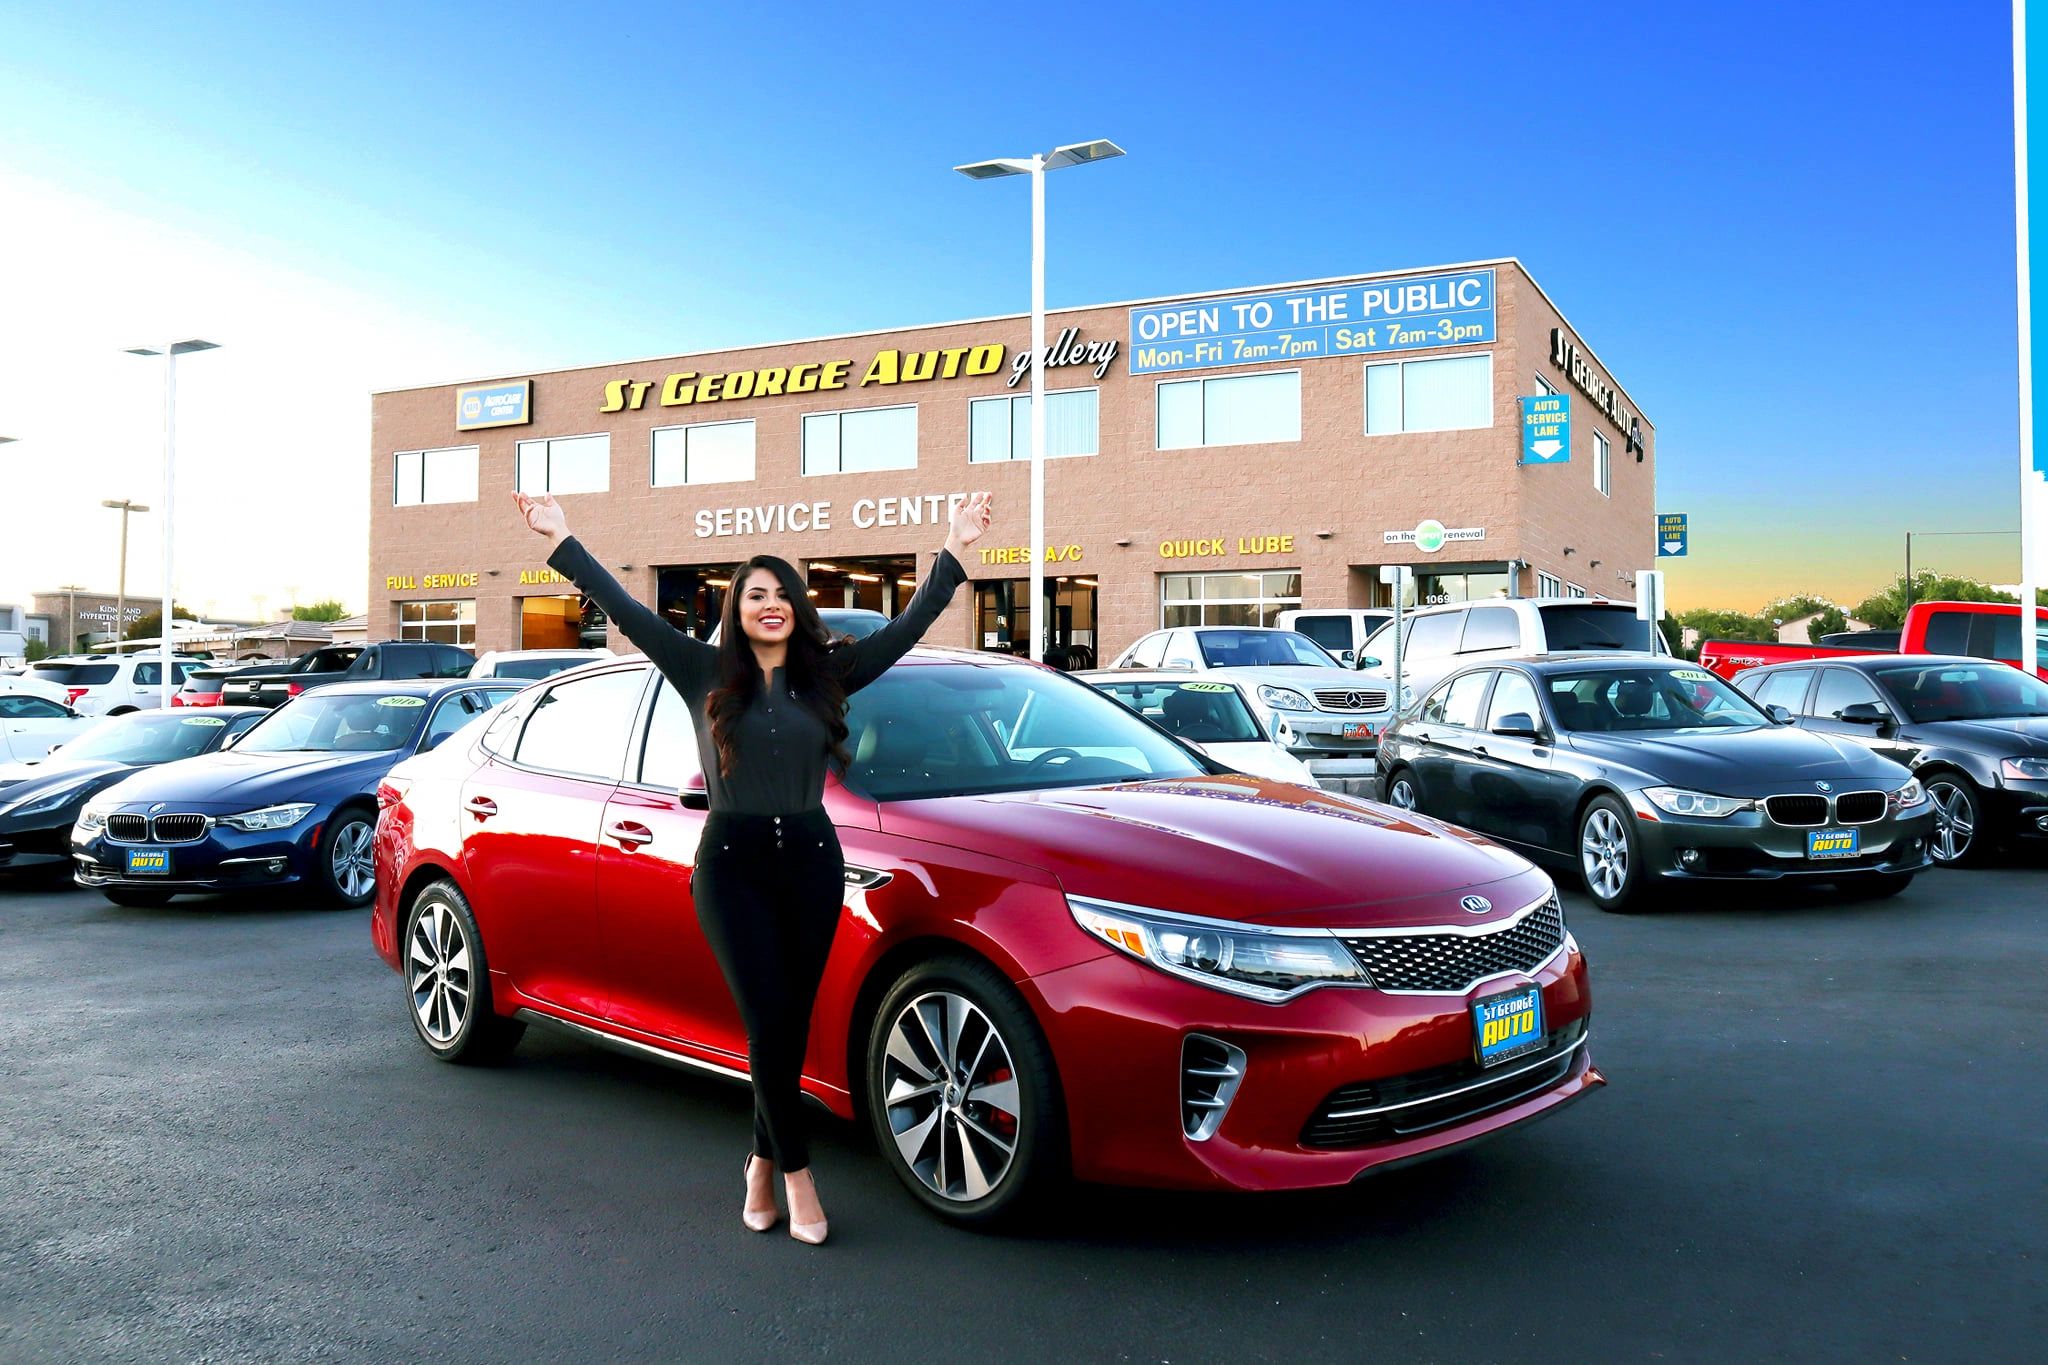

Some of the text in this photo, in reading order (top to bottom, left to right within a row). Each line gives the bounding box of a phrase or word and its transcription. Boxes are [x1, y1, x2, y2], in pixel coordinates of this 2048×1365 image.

[1138, 278, 1482, 340] OPEN TO THE PUBLIC
[1138, 319, 1483, 368] Mon-Fri 7am-7pm Sat 7am-3pm
[1534, 400, 1559, 411] AUTO
[1526, 412, 1567, 424] SERVICE
[1534, 425, 1559, 436] LANE
[694, 501, 831, 538] SERVICE
[1401, 532, 1416, 540] the
[1444, 529, 1483, 539] renewal
[979, 544, 1083, 565] TIRES A/C
[1159, 536, 1294, 558] QUICK LUBE
[386, 573, 479, 590] FULL SERVICE
[1813, 839, 1852, 851] AUTO
[131, 857, 164, 867] AUTO
[1464, 898, 1490, 911] KIA
[1484, 1006, 1497, 1021] ST
[1497, 995, 1534, 1017] GEORGE
[1482, 1009, 1535, 1048] AUTO
